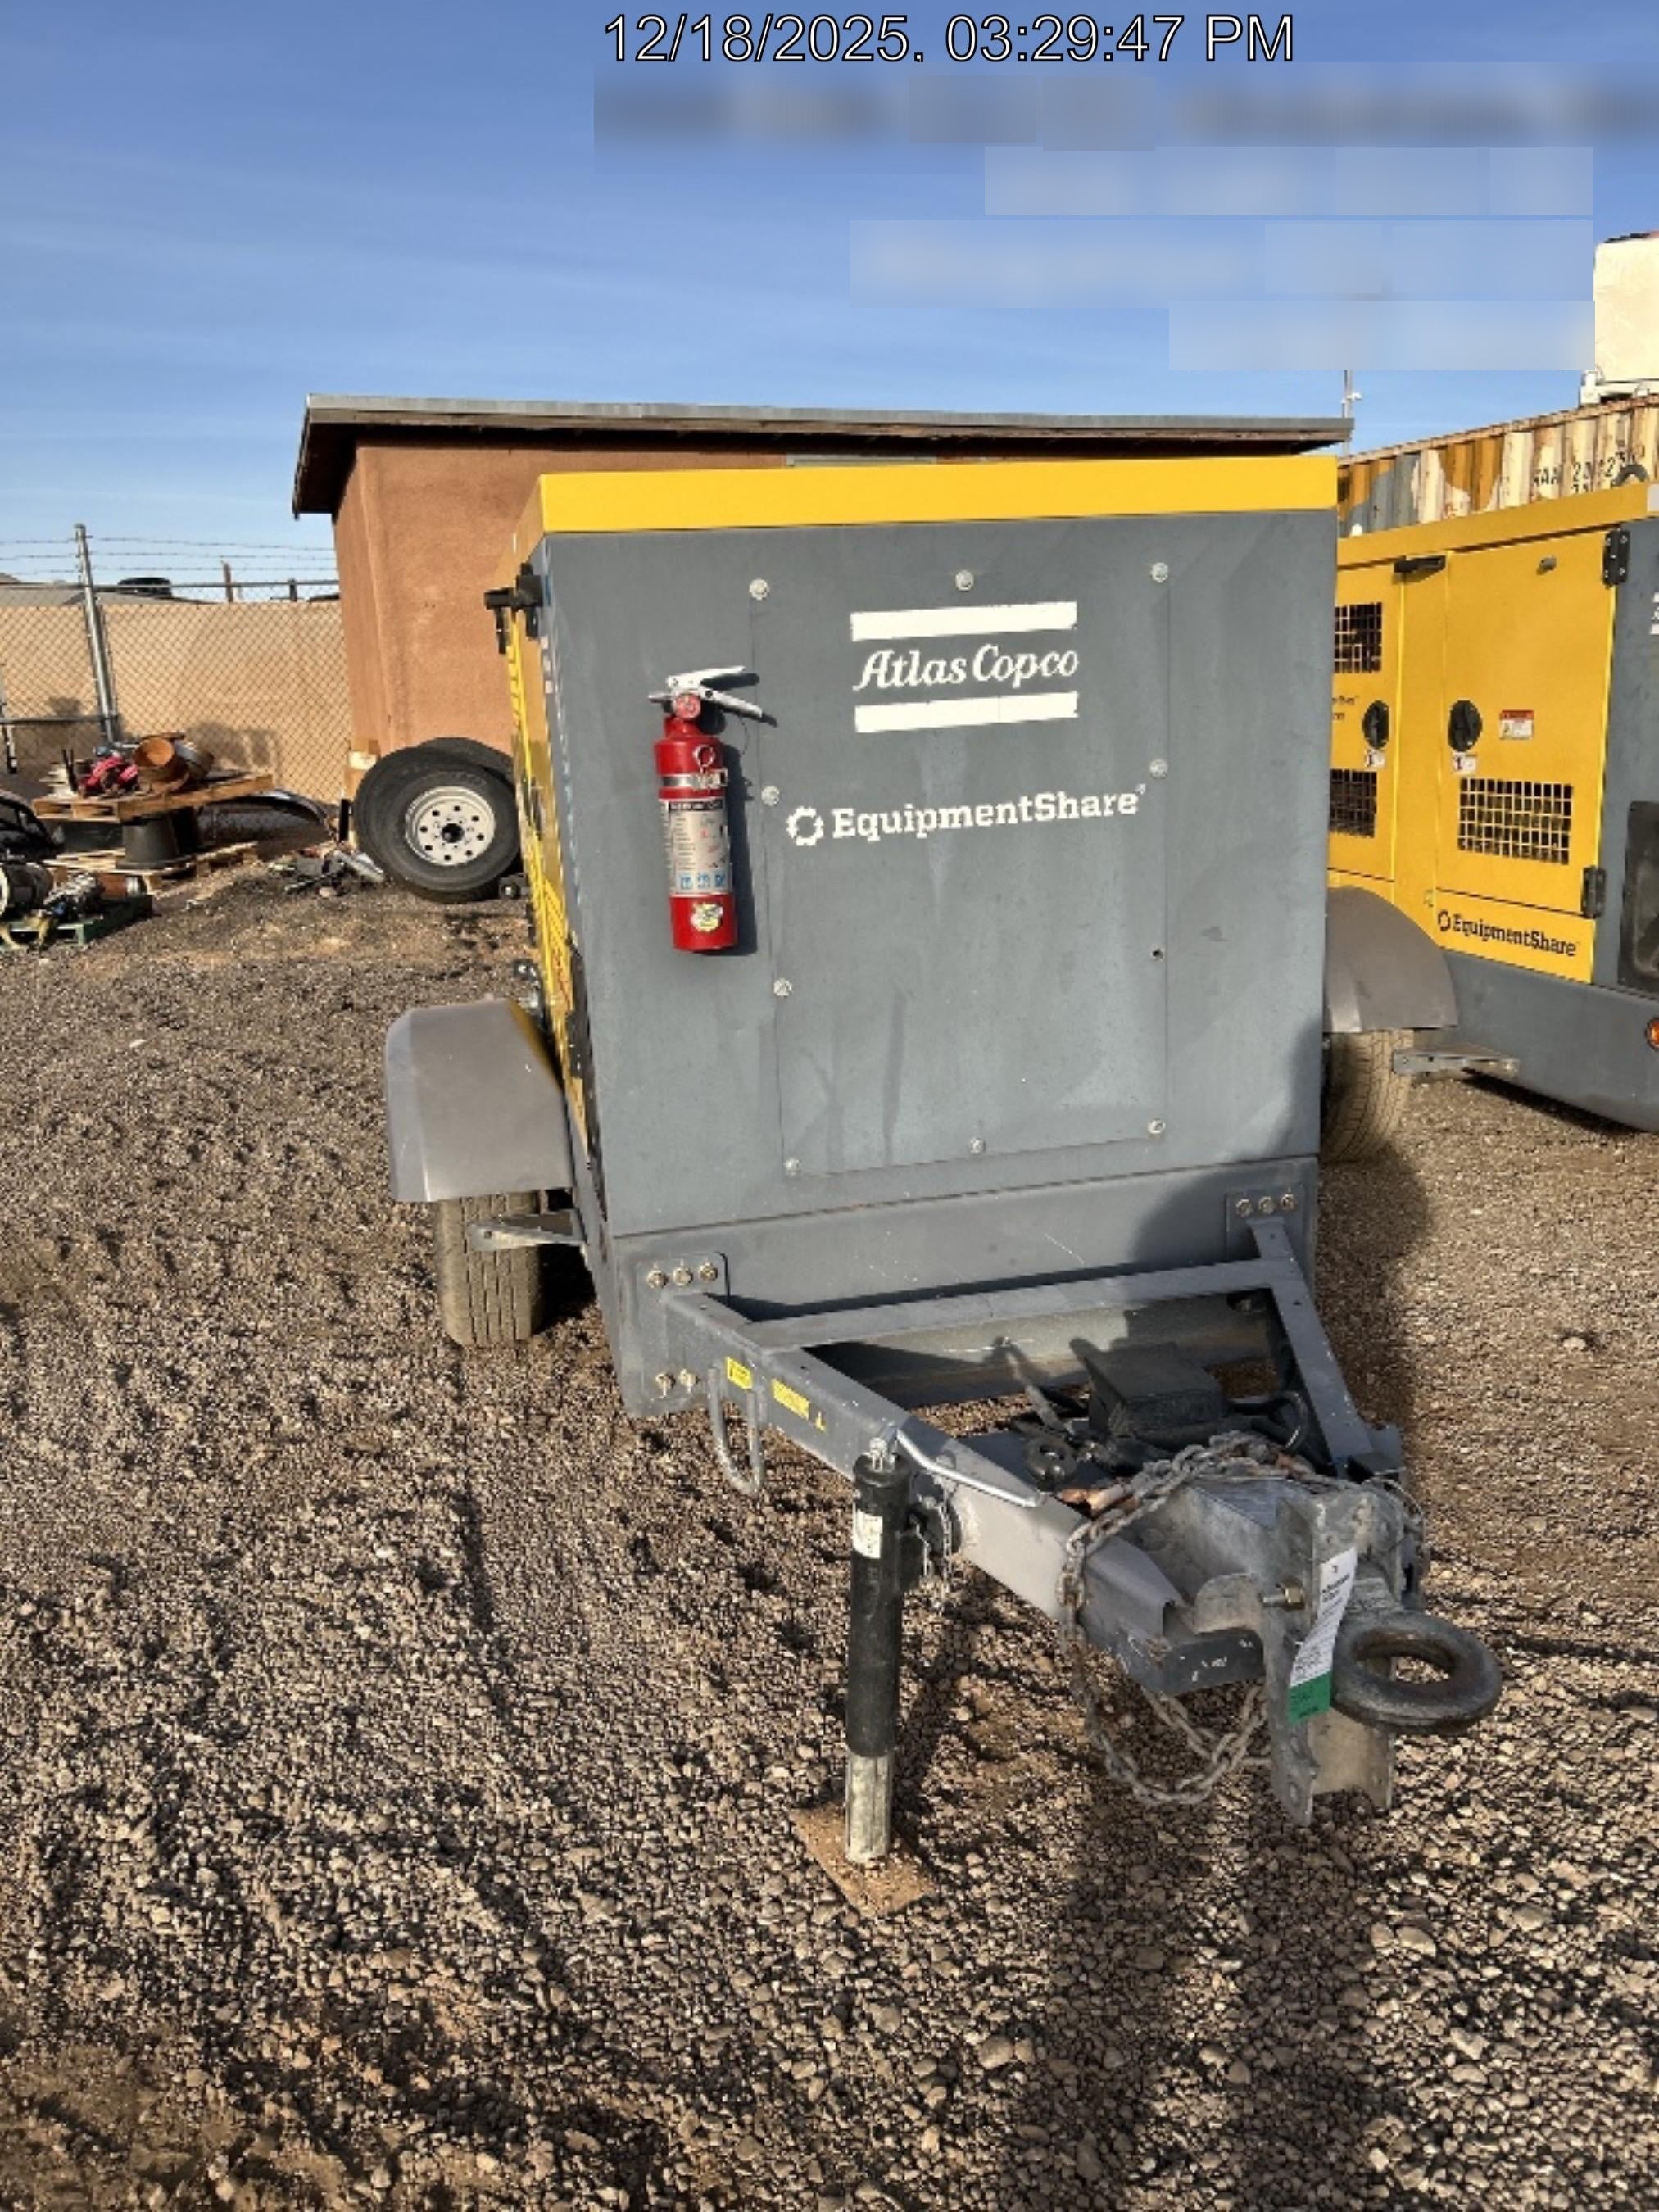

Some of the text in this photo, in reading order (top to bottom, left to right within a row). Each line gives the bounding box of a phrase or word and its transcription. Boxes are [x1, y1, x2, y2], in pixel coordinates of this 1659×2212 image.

[852, 644, 1079, 691] Atlas Copco
[831, 791, 1139, 842] EquipmentShare
[1453, 913, 1576, 957] EquipmentShare
